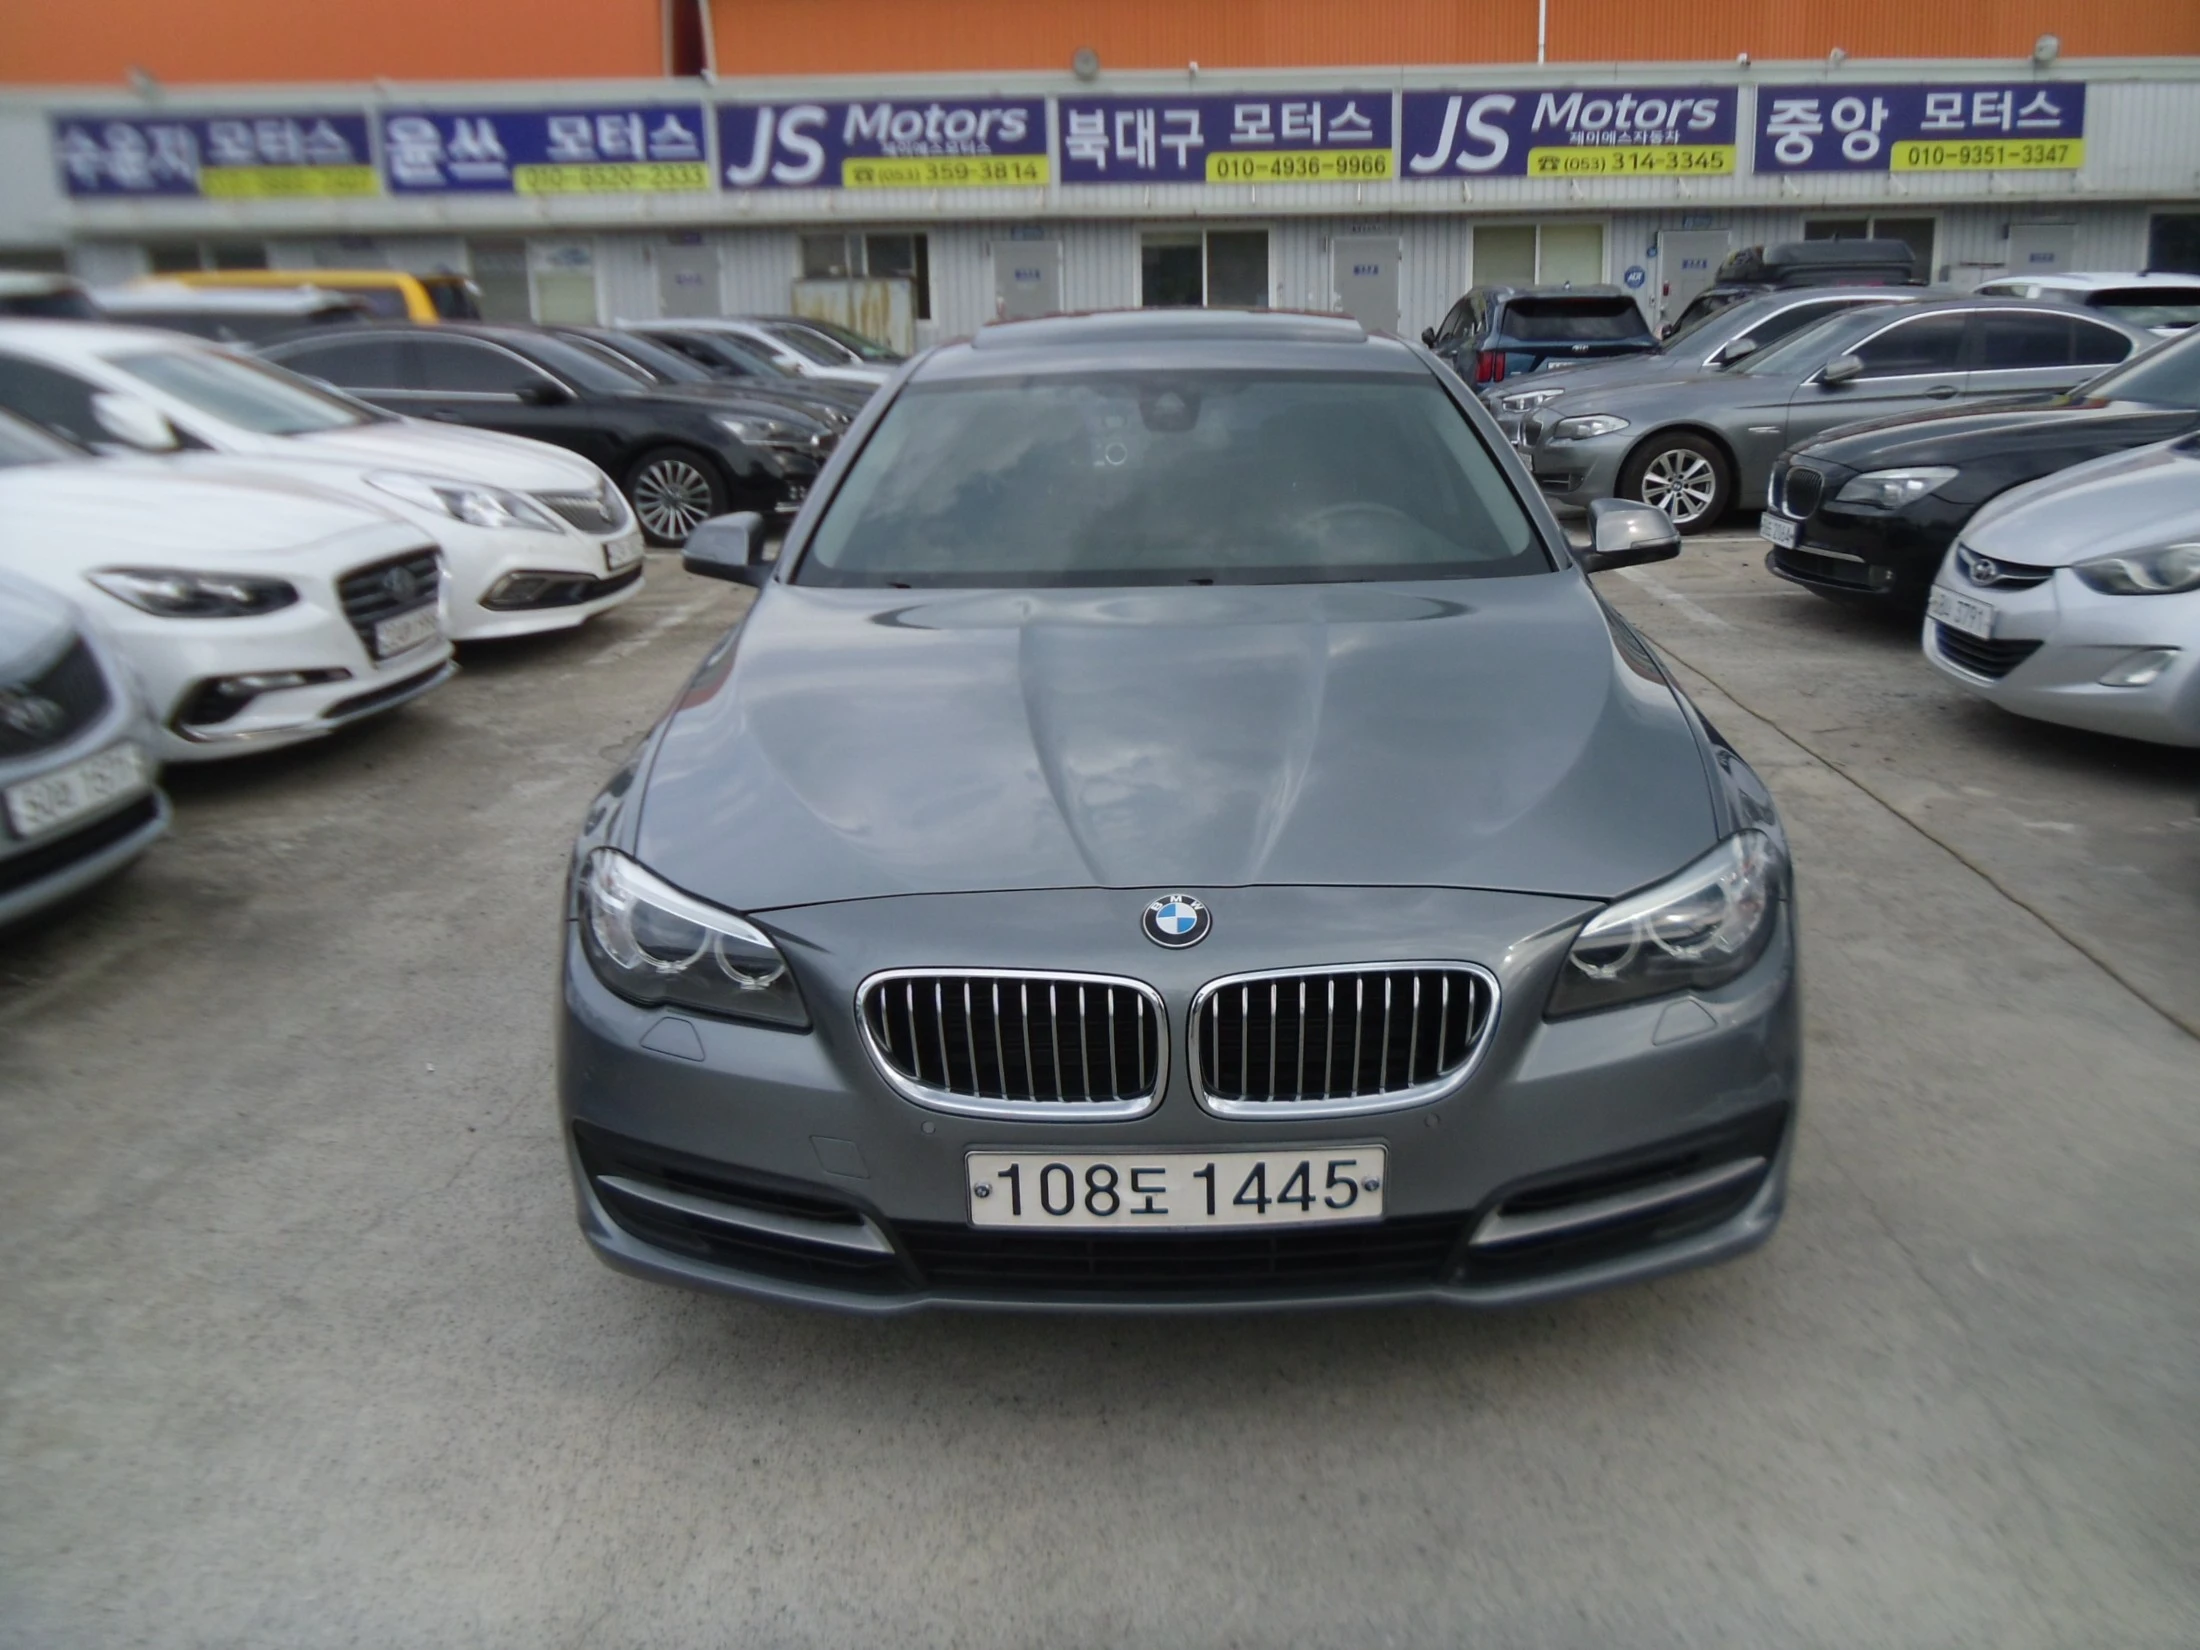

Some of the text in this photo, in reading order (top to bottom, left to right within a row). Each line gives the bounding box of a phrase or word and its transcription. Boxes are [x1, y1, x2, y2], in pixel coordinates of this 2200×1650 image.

[547, 112, 700, 162] 모터스
[726, 103, 1028, 186] JS Motors
[1065, 101, 1373, 170] 북대구 모터스
[1409, 92, 1719, 172] JS Motors
[1569, 129, 1680, 146] 제이에스자동차
[1766, 90, 2061, 164] 중앙 모터스
[925, 161, 1038, 181] 359-3814
[1217, 155, 1386, 178] 010-4936-9966
[1563, 151, 1724, 172] (053) 314-3345
[1908, 144, 2069, 166] 010-9351-3347
[1151, 895, 1204, 911] BMW
[998, 1159, 1360, 1216] 108도 1445
